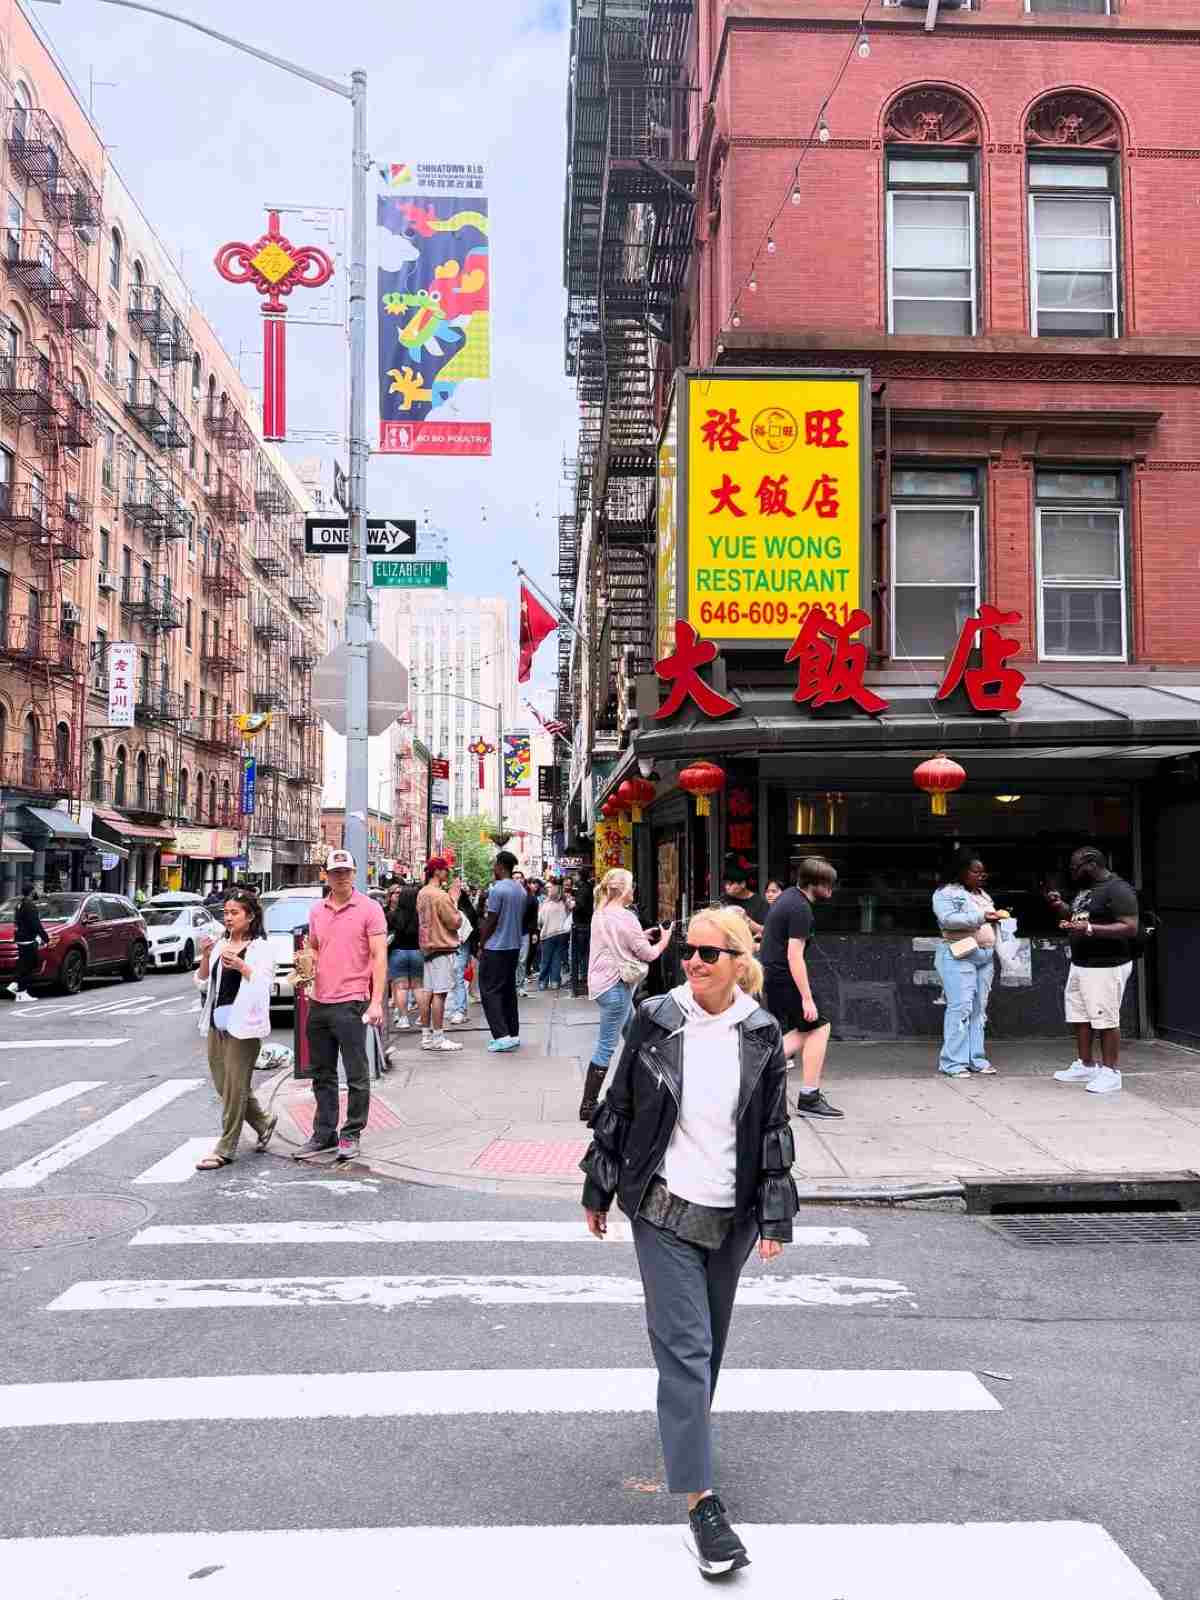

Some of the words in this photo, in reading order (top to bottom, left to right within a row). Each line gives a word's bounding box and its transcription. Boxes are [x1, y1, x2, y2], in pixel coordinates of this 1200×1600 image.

[416, 163, 465, 173] CHINATOWN
[447, 435, 489, 445] POULTRY
[804, 408, 849, 449] 旺
[708, 473, 840, 519] 大飯店
[320, 529, 349, 543] ONE
[368, 529, 400, 544] WAY
[708, 536, 756, 560] YUE
[764, 535, 841, 560] WONG
[375, 561, 432, 577] ELIZABETH
[696, 569, 849, 593] RESTAURANT
[653, 603, 1025, 720] 大飯店
